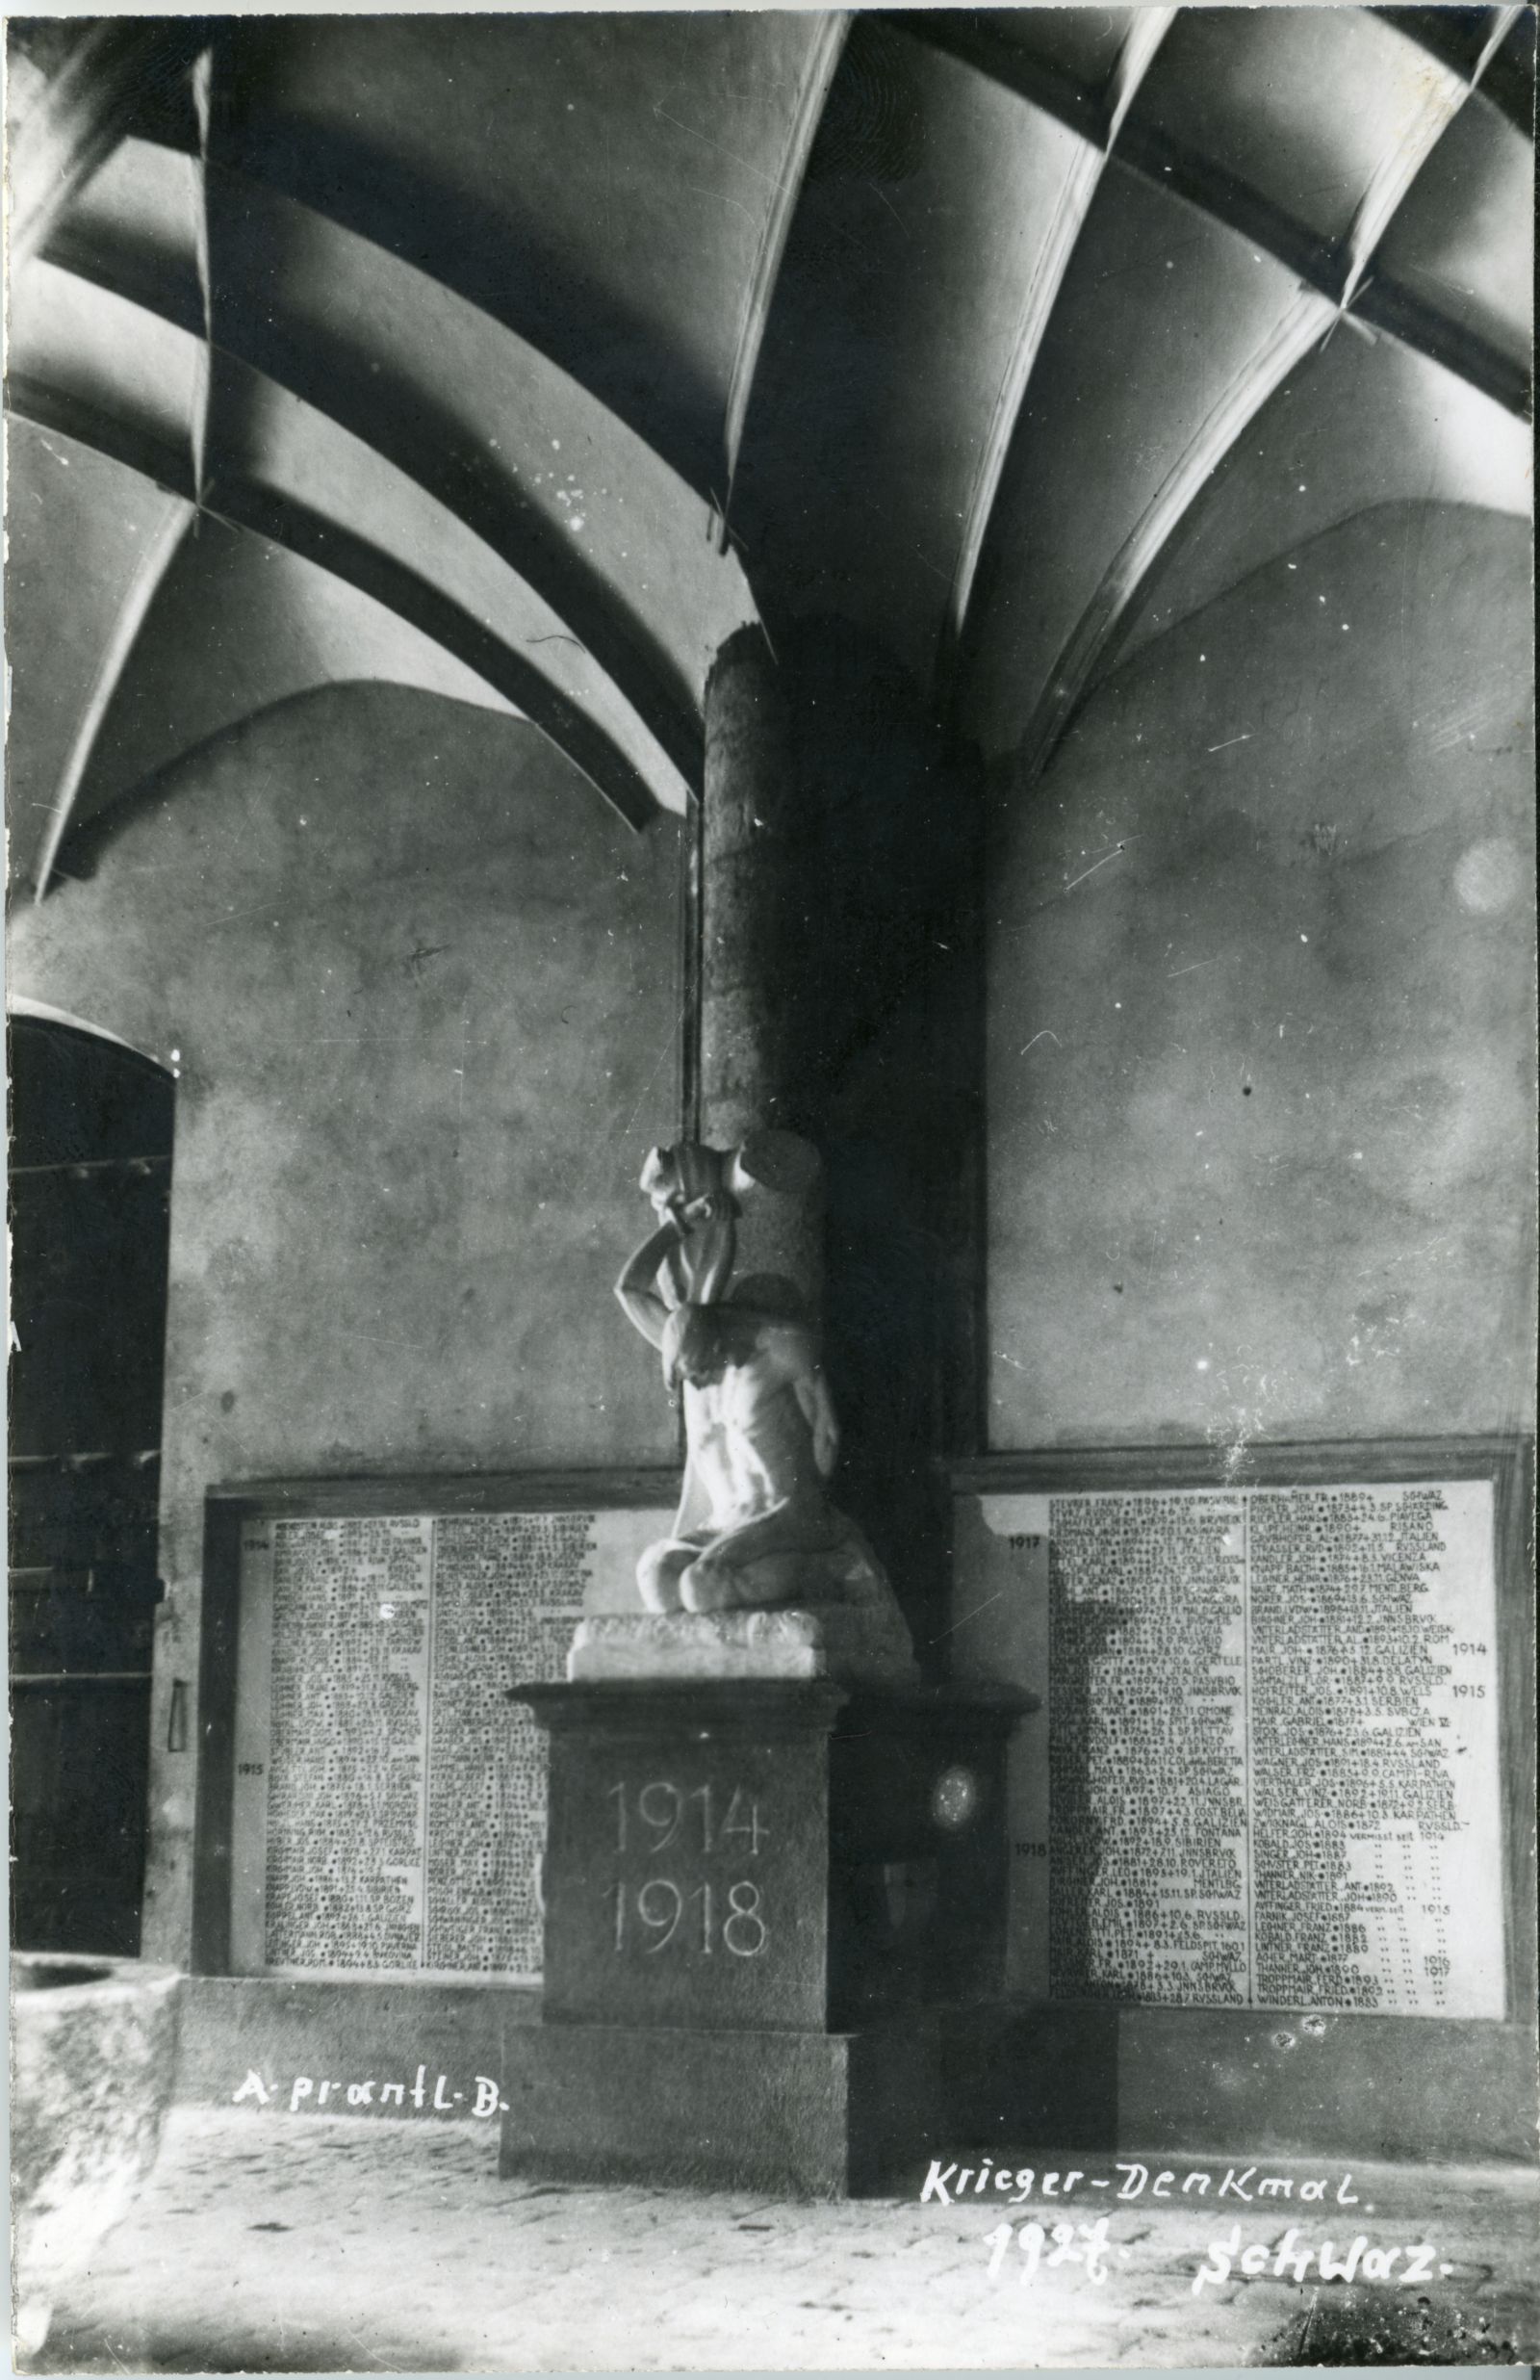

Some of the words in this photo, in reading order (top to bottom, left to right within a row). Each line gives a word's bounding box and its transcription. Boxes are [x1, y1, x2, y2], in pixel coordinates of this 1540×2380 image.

[1009, 1535, 1040, 1550] 1917
[1452, 1643, 1488, 1657] 1914
[1451, 1684, 1487, 1698] 1915
[1406, 1717, 1435, 1726] WIEN
[238, 1763, 263, 1776] 1915
[607, 1781, 771, 1855] 1914
[1014, 1842, 1047, 1858] 1918
[1422, 1903, 1451, 1915] 1915
[601, 1878, 769, 1956] 1918
[1339, 1924, 1367, 1934] 1886
